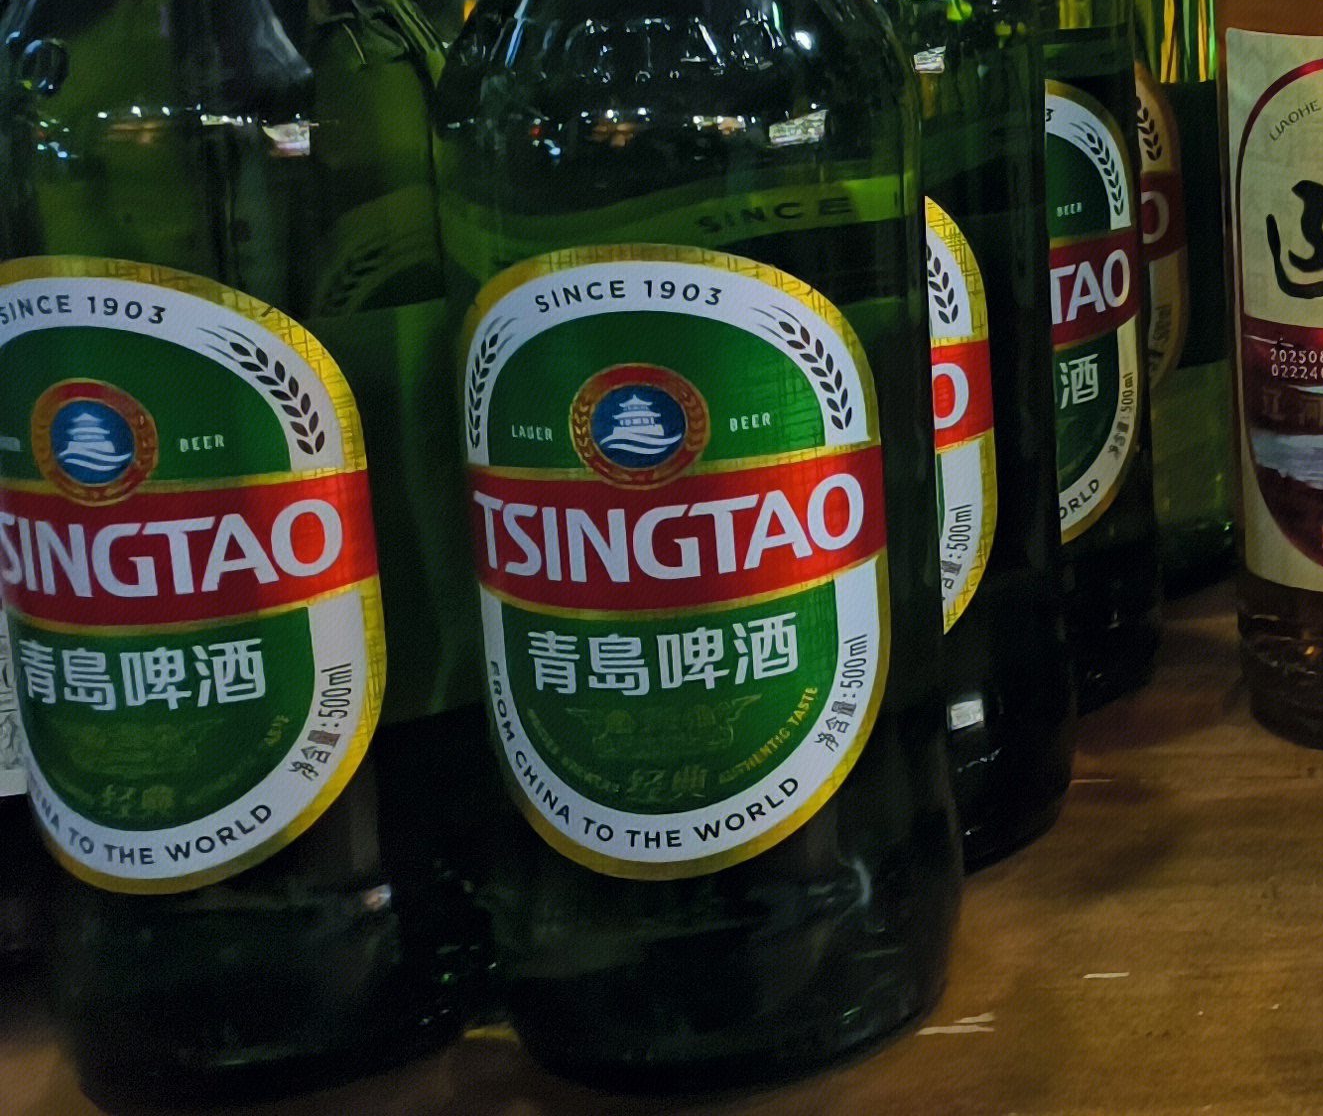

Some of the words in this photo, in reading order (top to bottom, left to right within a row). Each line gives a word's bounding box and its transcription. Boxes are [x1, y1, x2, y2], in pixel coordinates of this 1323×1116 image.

[1268, 99, 1322, 143] LIAOHE
[87, 295, 167, 325] 1903
[534, 279, 627, 314] SINCE
[643, 279, 723, 306] 1903
[729, 412, 772, 433] BEER
[179, 434, 225, 452] BEER
[473, 472, 865, 584] TSINGTAO
[487, 660, 516, 743] FROM
[514, 749, 570, 825] CHINA
[582, 816, 614, 842] TO
[625, 829, 682, 850] THE
[692, 776, 800, 843] WORLD
[68, 826, 95, 855] TO
[103, 842, 156, 866] THE
[164, 803, 273, 863] WORLD
